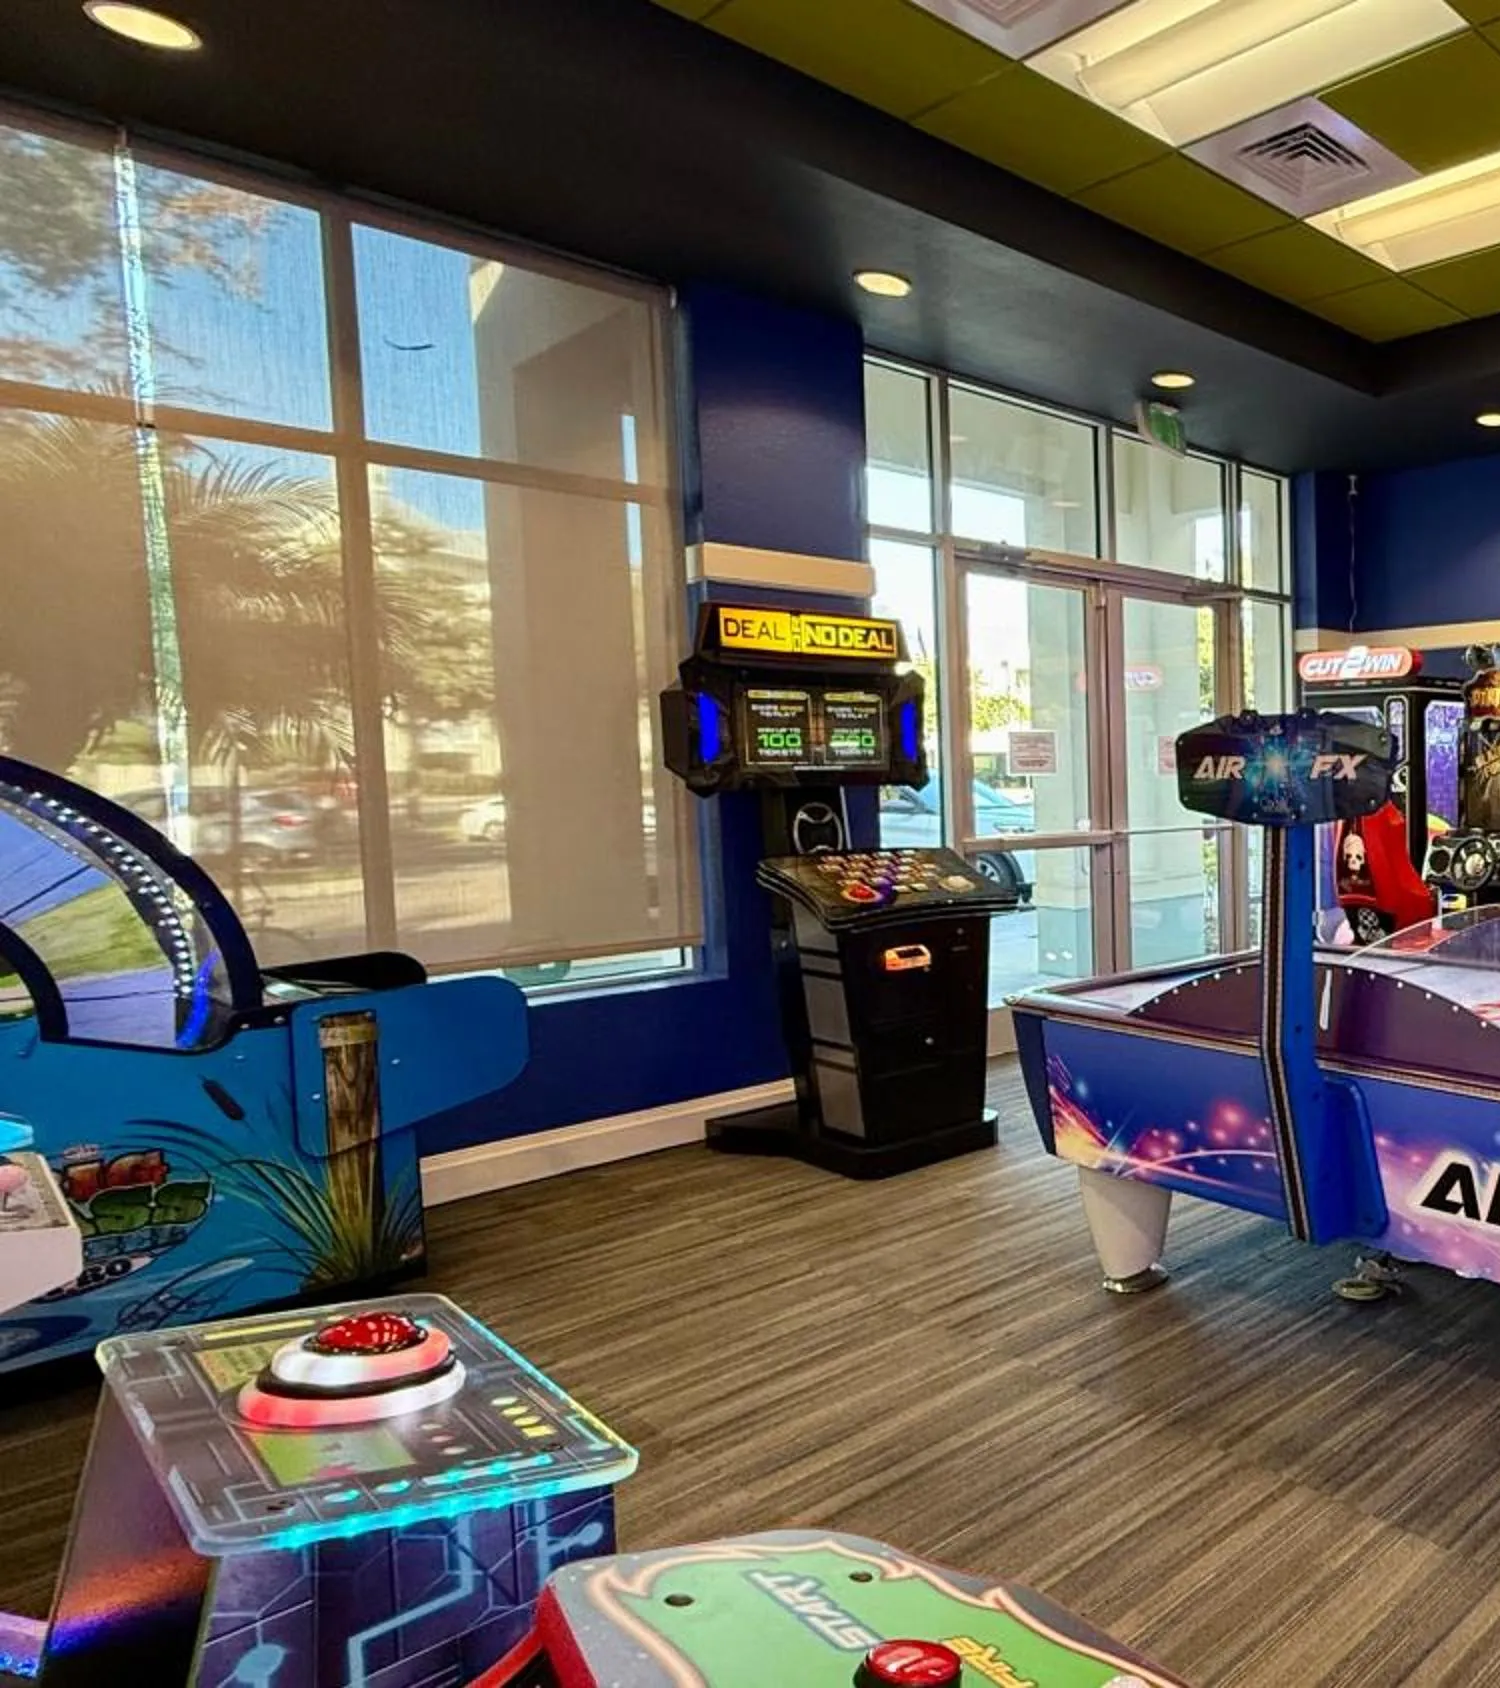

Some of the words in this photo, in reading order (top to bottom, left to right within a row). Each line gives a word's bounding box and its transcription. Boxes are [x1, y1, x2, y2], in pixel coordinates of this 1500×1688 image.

[723, 617, 785, 641] DEAL
[805, 624, 836, 647] NO
[838, 628, 894, 649] DEAL
[758, 733, 801, 748] 100
[1192, 755, 1246, 780] AIR
[1309, 754, 1368, 780] FX
[745, 1570, 882, 1651] START
